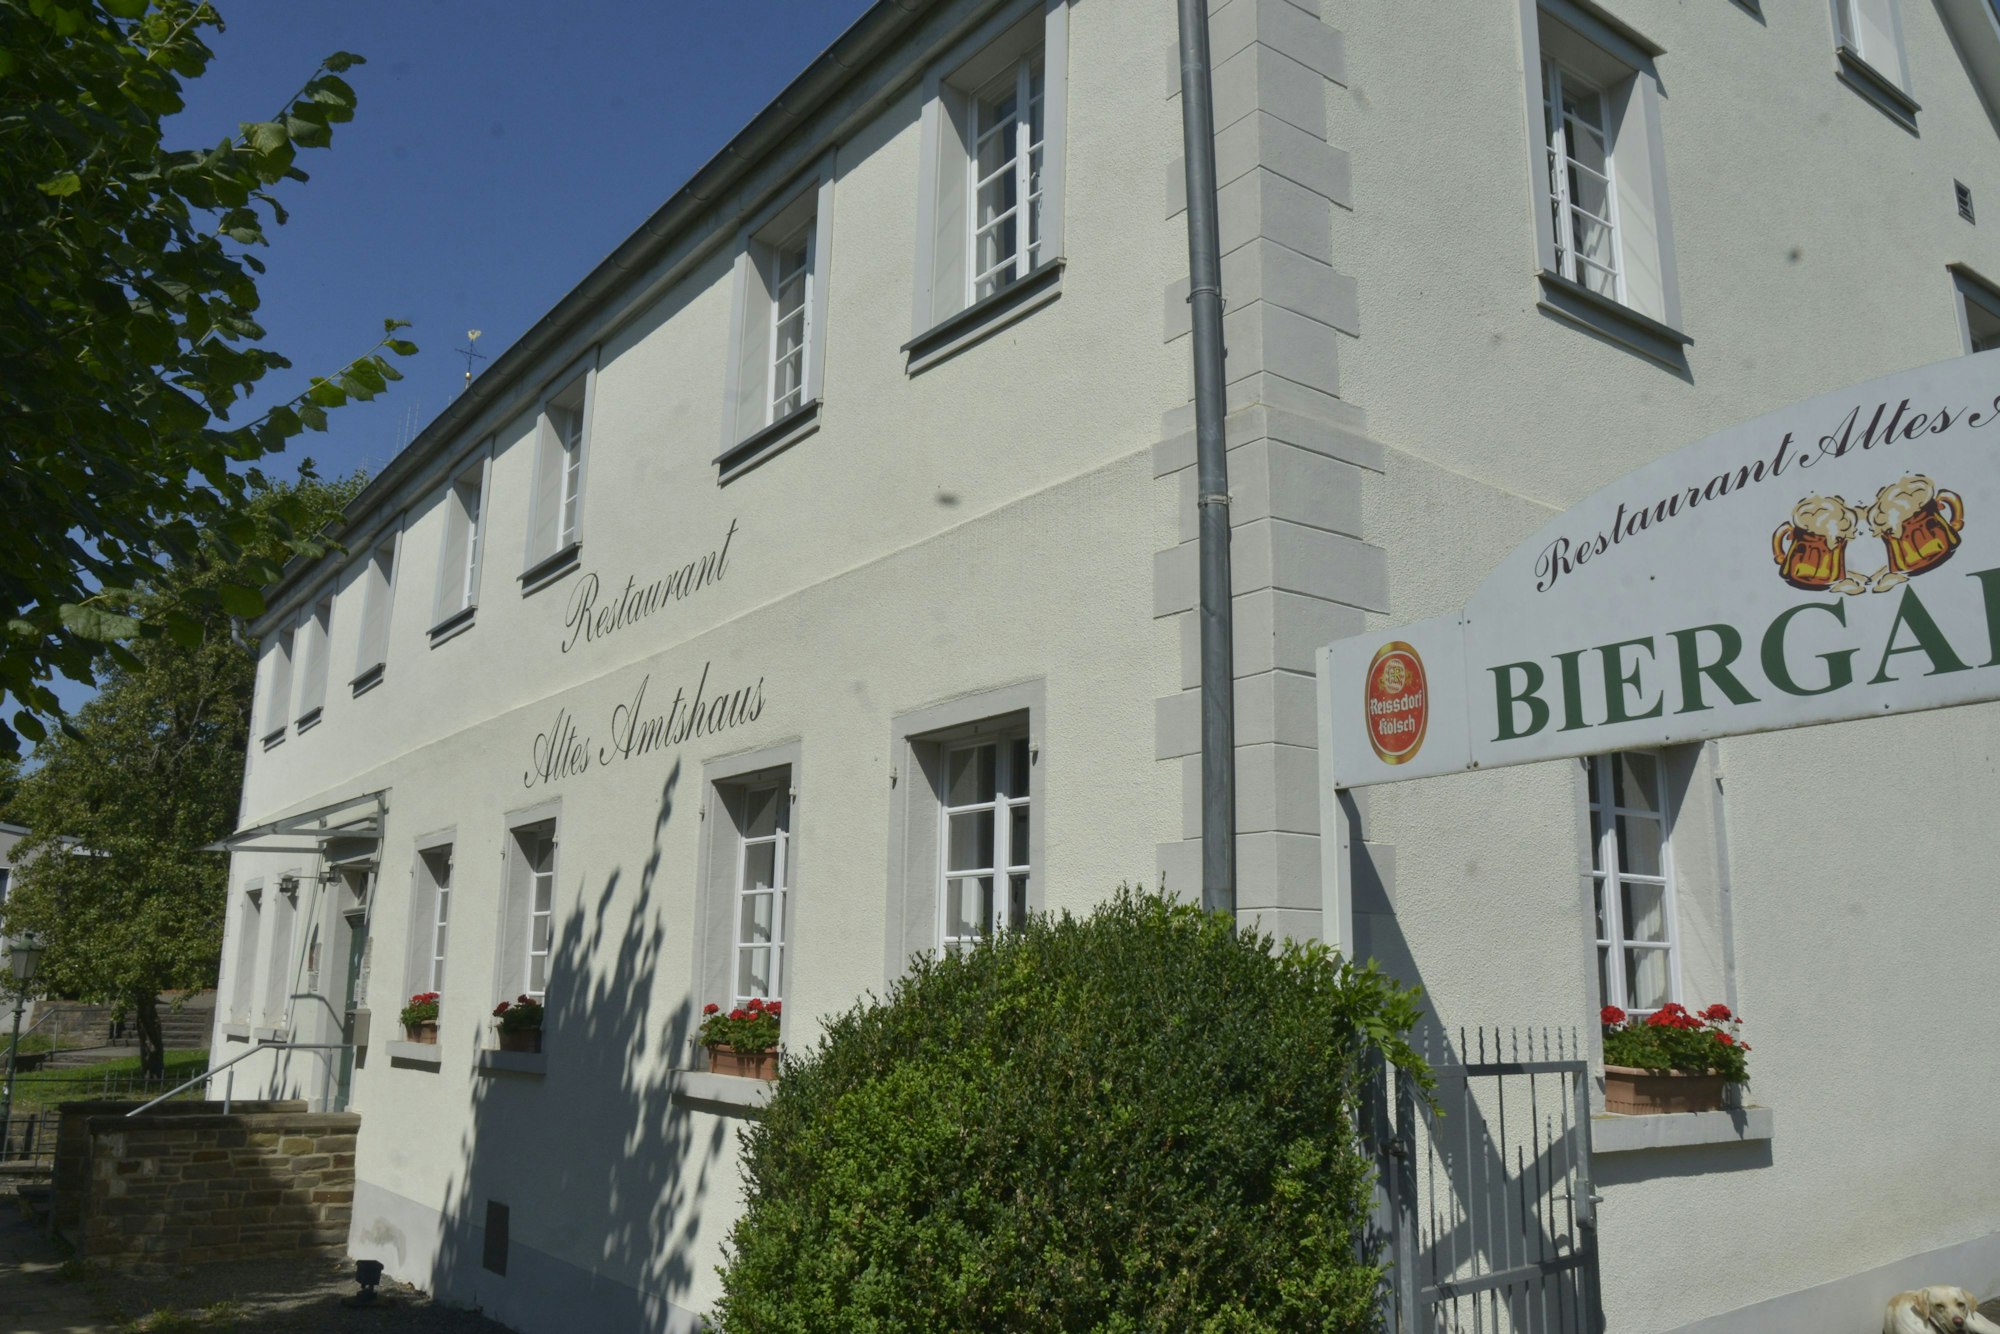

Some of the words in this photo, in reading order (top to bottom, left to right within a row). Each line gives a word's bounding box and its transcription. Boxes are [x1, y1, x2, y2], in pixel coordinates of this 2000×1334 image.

[1534, 431, 1798, 593] Restaurant
[1799, 397, 1967, 469] Altes
[561, 517, 739, 654] Restaurant
[523, 706, 591, 789] Altes
[599, 660, 766, 766] Amtshaus
[1370, 690, 1423, 716] Reissdorf
[1379, 714, 1415, 735] Kölsch
